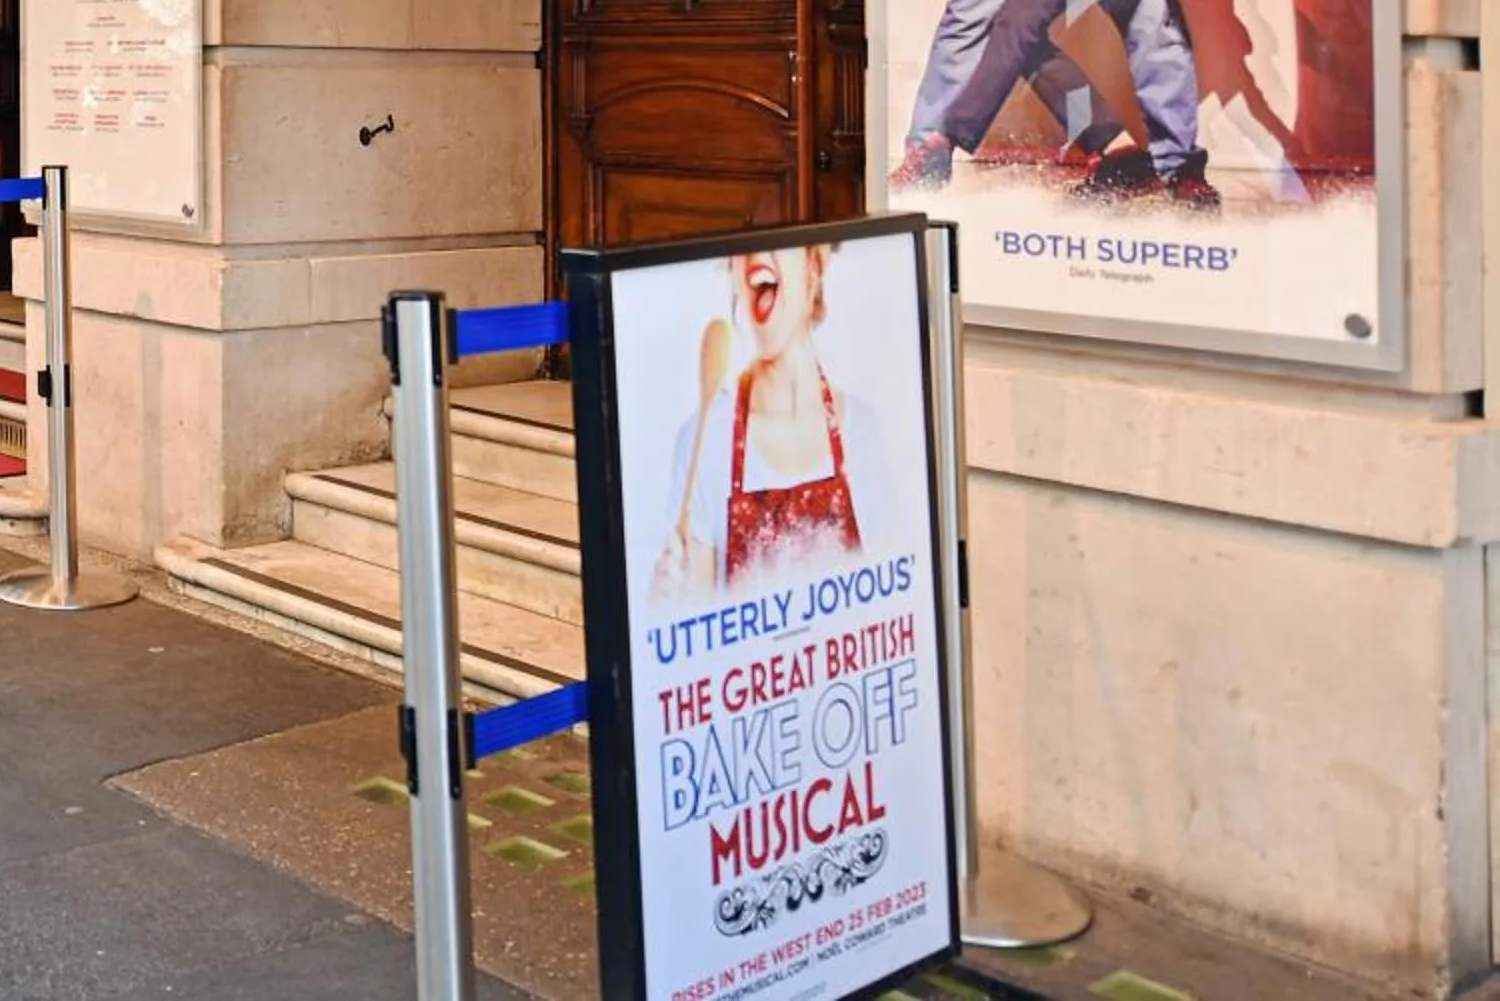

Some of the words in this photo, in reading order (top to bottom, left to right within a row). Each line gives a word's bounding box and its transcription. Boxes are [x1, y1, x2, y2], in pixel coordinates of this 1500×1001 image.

[1068, 266, 1095, 280] Daily
[1099, 268, 1155, 283] Telegraph
[647, 588, 794, 665] 'UTTERLY
[658, 678, 713, 736] THE
[721, 644, 817, 713] GREAT
[826, 613, 916, 681] BRITISH
[660, 698, 802, 831] BAKE
[811, 658, 918, 769] OFF
[708, 760, 887, 886] MUSICAL
[719, 968, 735, 989] IN
[739, 952, 768, 980] THE
[771, 934, 812, 963] WEST
[815, 919, 845, 946] END
[848, 908, 864, 931] 25
[867, 896, 893, 920] FEB
[844, 921, 886, 951] COWARD
[887, 903, 927, 928] THEATRE
